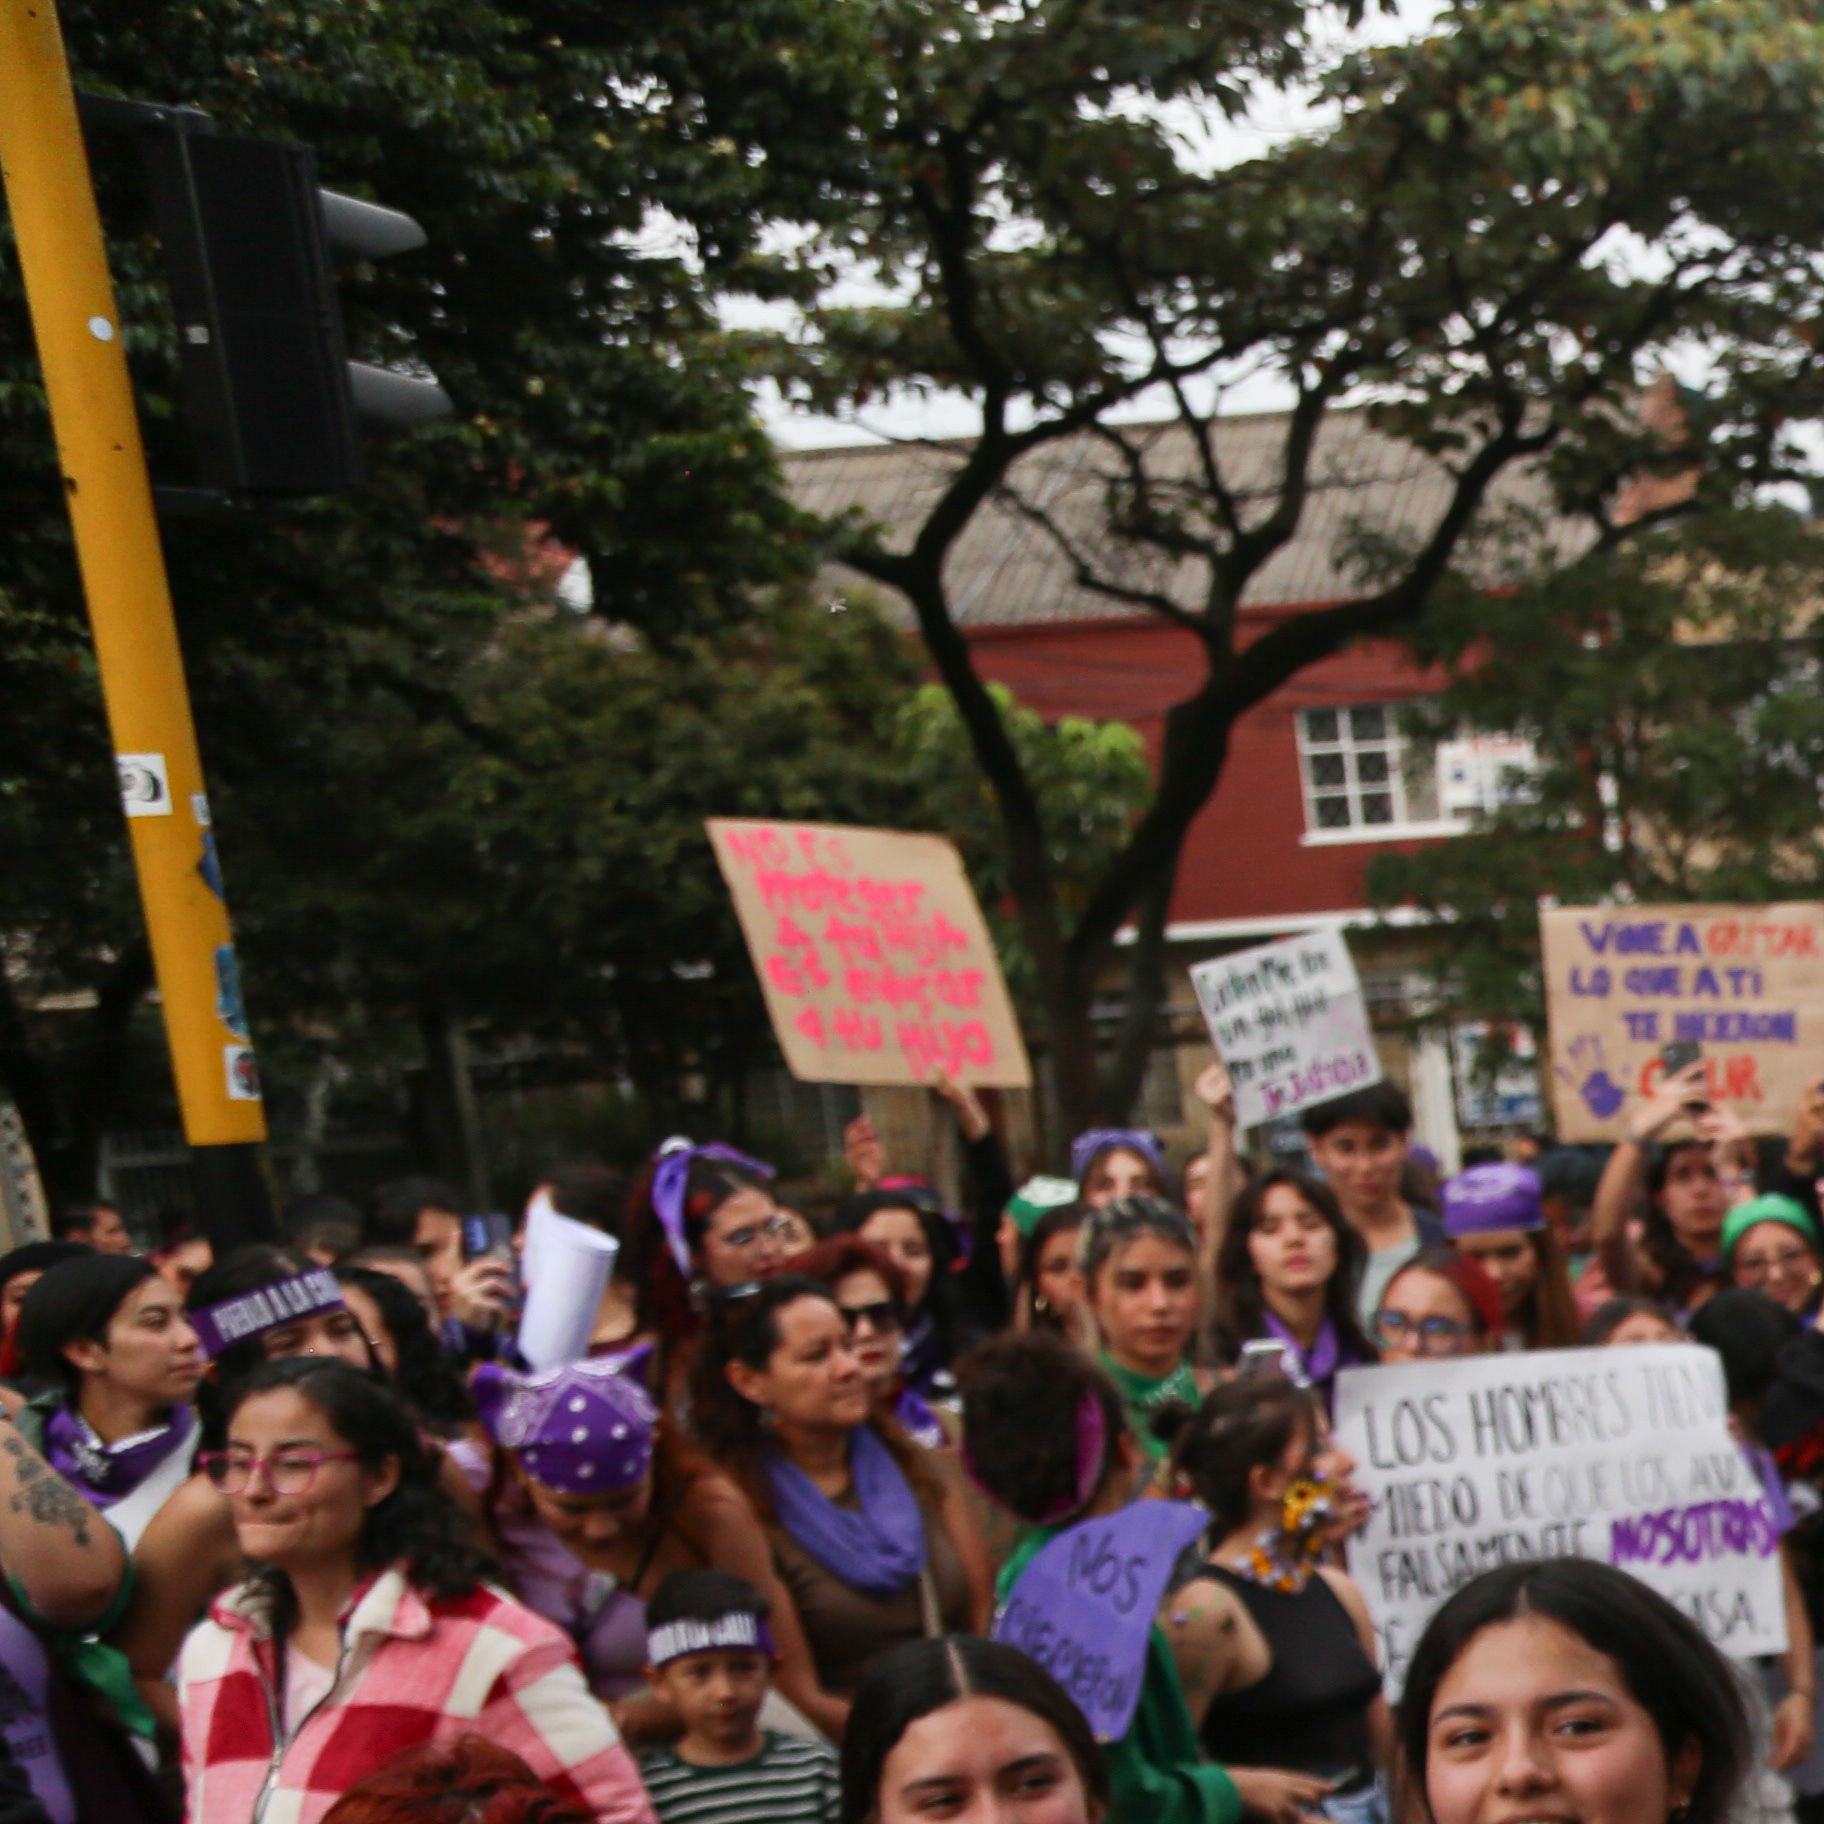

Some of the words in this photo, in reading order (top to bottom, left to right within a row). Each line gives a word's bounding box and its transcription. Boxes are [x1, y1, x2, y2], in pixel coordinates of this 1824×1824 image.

[1675, 922, 1701, 956] A
[1570, 966, 1612, 997] LO
[1625, 967, 1681, 997] QUE
[1693, 967, 1721, 997] A
[1622, 1011, 1660, 1042] TE
[1363, 1392, 1458, 1470] LOS
[1469, 1372, 1632, 1458] HOMBRES
[1498, 1466, 1534, 1520] DE
[1541, 1459, 1612, 1519] QUE
[1609, 1498, 1779, 1566] NOSOTRAS
[1065, 1532, 1151, 1615] NOS
